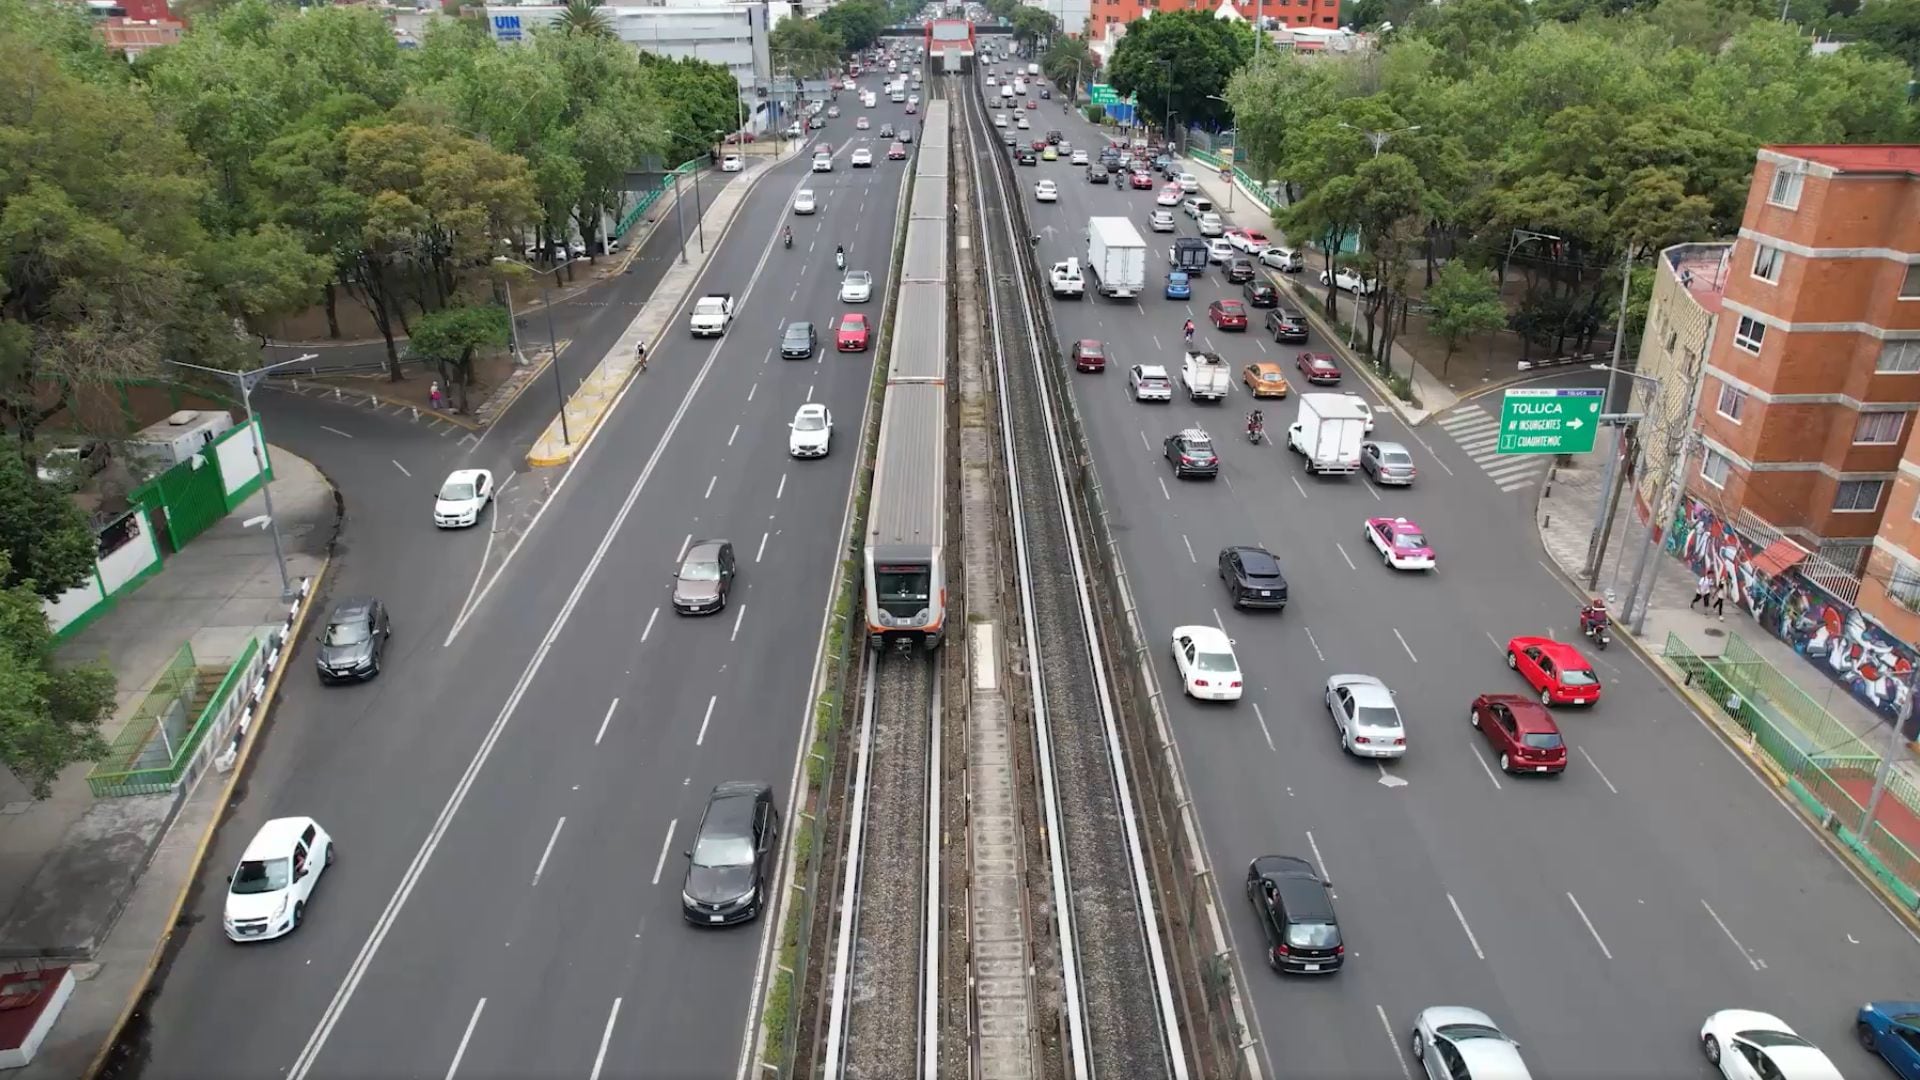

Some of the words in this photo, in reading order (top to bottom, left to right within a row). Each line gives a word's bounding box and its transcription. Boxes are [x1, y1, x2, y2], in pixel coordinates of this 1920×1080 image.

[495, 16, 520, 28] UIN
[1512, 403, 1562, 414] TOLUCA
[1519, 419, 1561, 430] INSURGENTES
